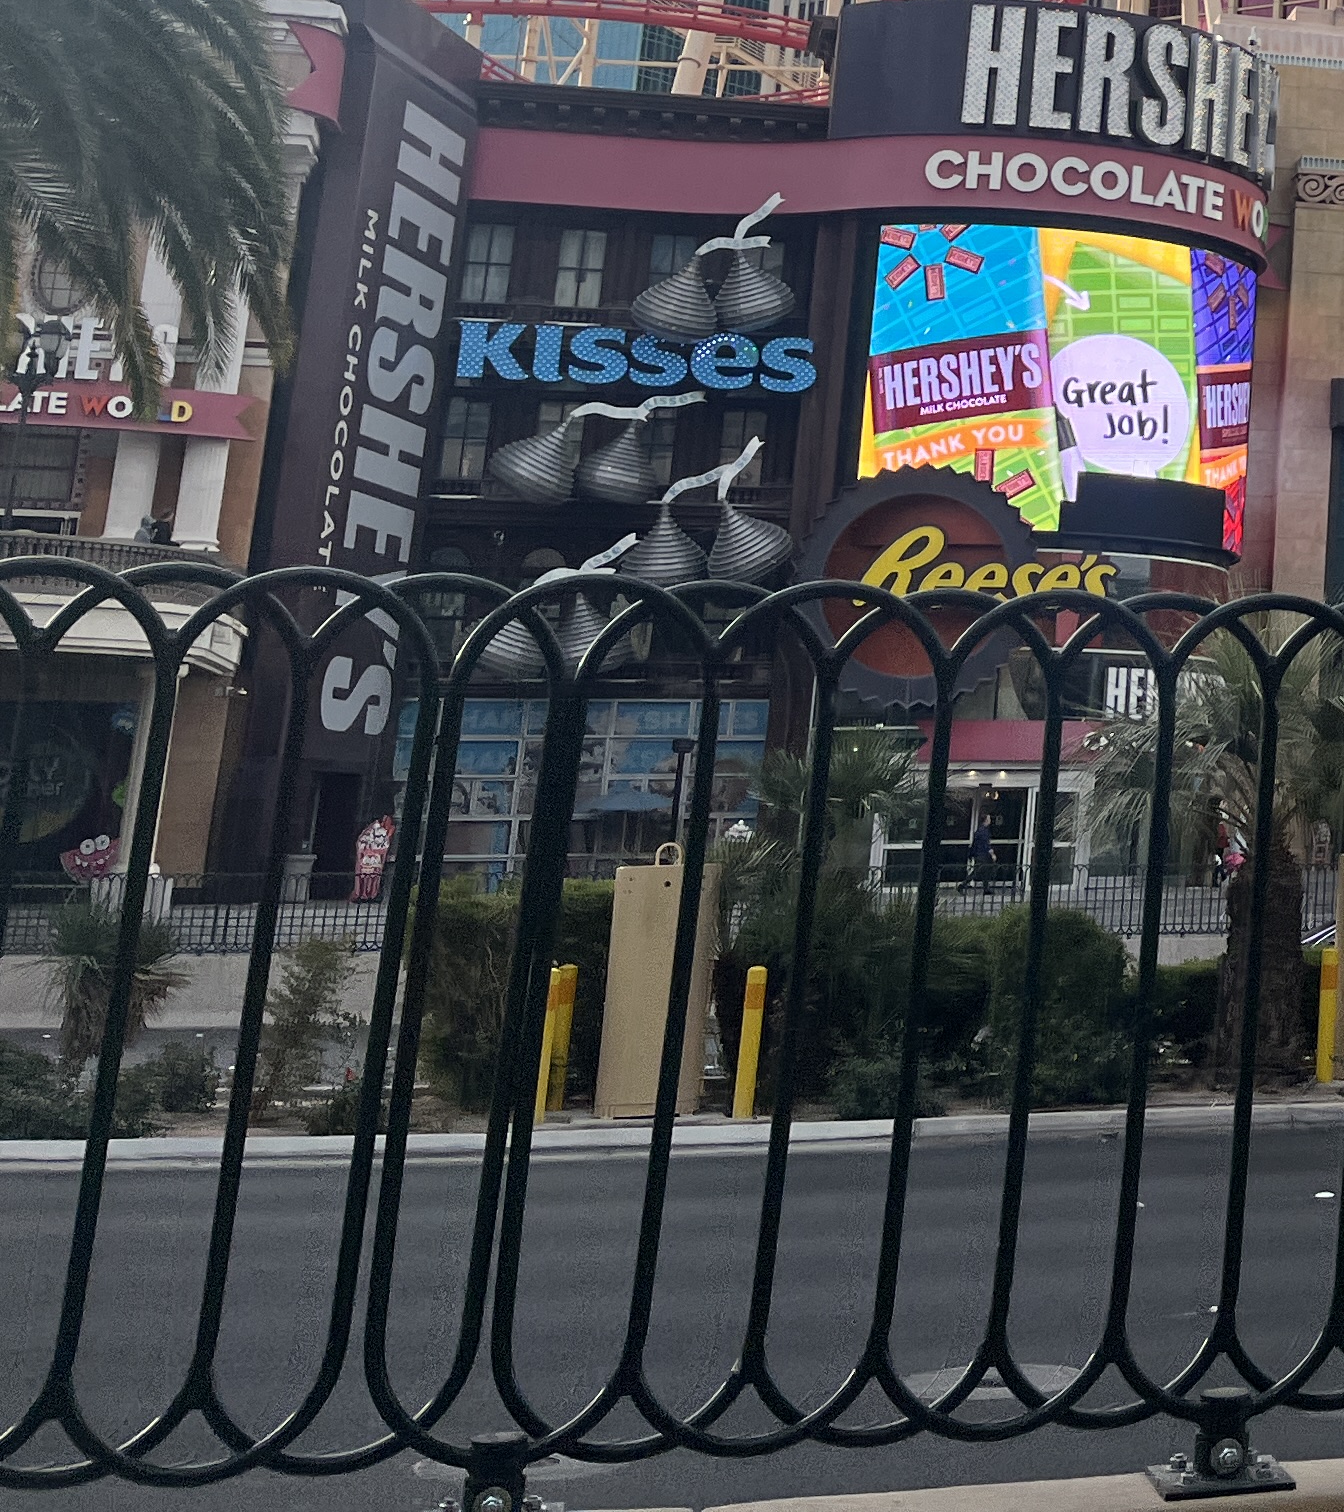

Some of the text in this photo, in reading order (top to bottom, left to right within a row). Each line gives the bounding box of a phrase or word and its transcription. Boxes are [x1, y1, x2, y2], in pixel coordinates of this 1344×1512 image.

[924, 149, 1226, 221] CHOCOLATE
[313, 208, 379, 592] MILK CHOCOLAT
[883, 343, 1043, 410] HERSHEY'S
[1062, 369, 1158, 408] Great
[920, 395, 1007, 415] MILK CHOCOLATE
[882, 435, 966, 469] THANK
[972, 424, 1024, 443] YOU
